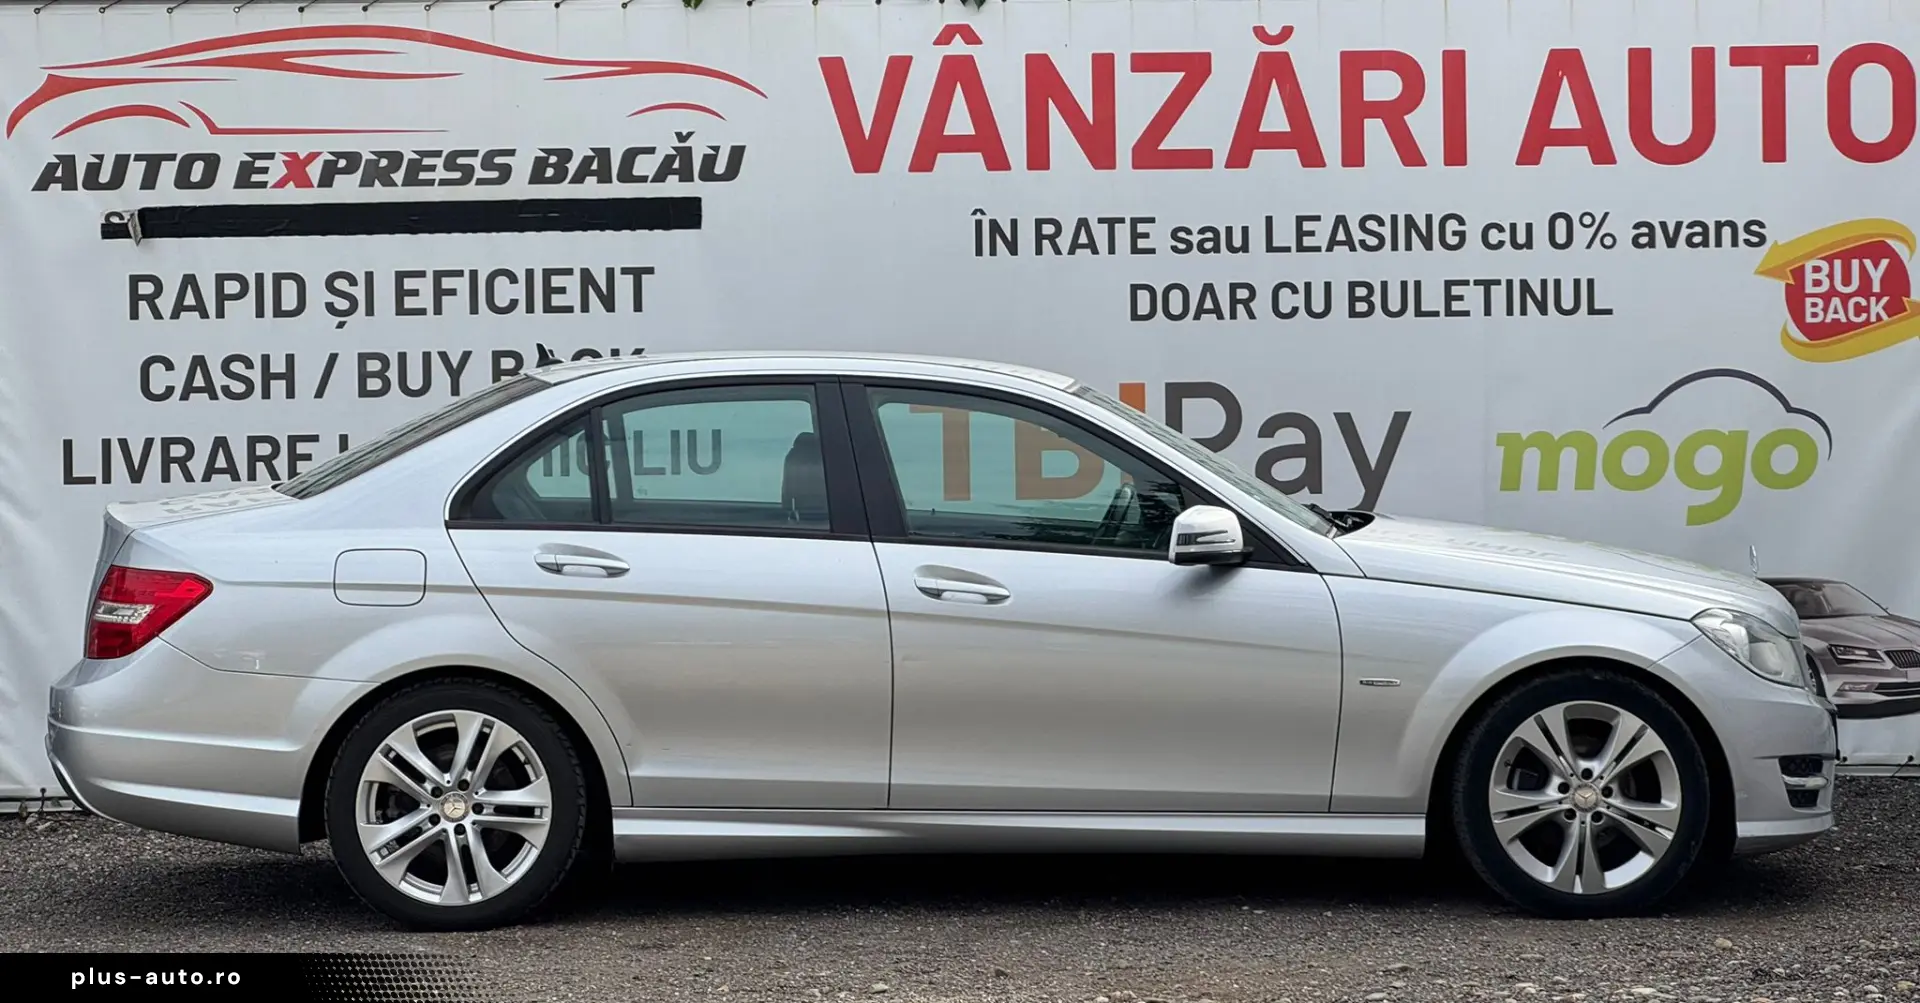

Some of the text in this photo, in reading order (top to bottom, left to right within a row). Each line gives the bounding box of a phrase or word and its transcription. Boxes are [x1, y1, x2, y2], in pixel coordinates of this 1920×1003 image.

[820, 23, 1918, 174] VÂNZĂRI AUTO
[31, 130, 747, 192] AUTO EXPRESS BACĂU
[970, 208, 1768, 257] ÎN RATE sau LEASING cu 0% avans
[128, 271, 307, 321] RAPID
[394, 266, 656, 317] EFICIENT
[1129, 277, 1614, 322] DOAR CU BULETINUL
[1804, 258, 1890, 294] BUY
[1805, 296, 1890, 323] BACK
[139, 353, 296, 402] CASH
[357, 350, 473, 399] BUY
[62, 433, 320, 486] LIVRARE
[1495, 428, 1819, 526] mogo
